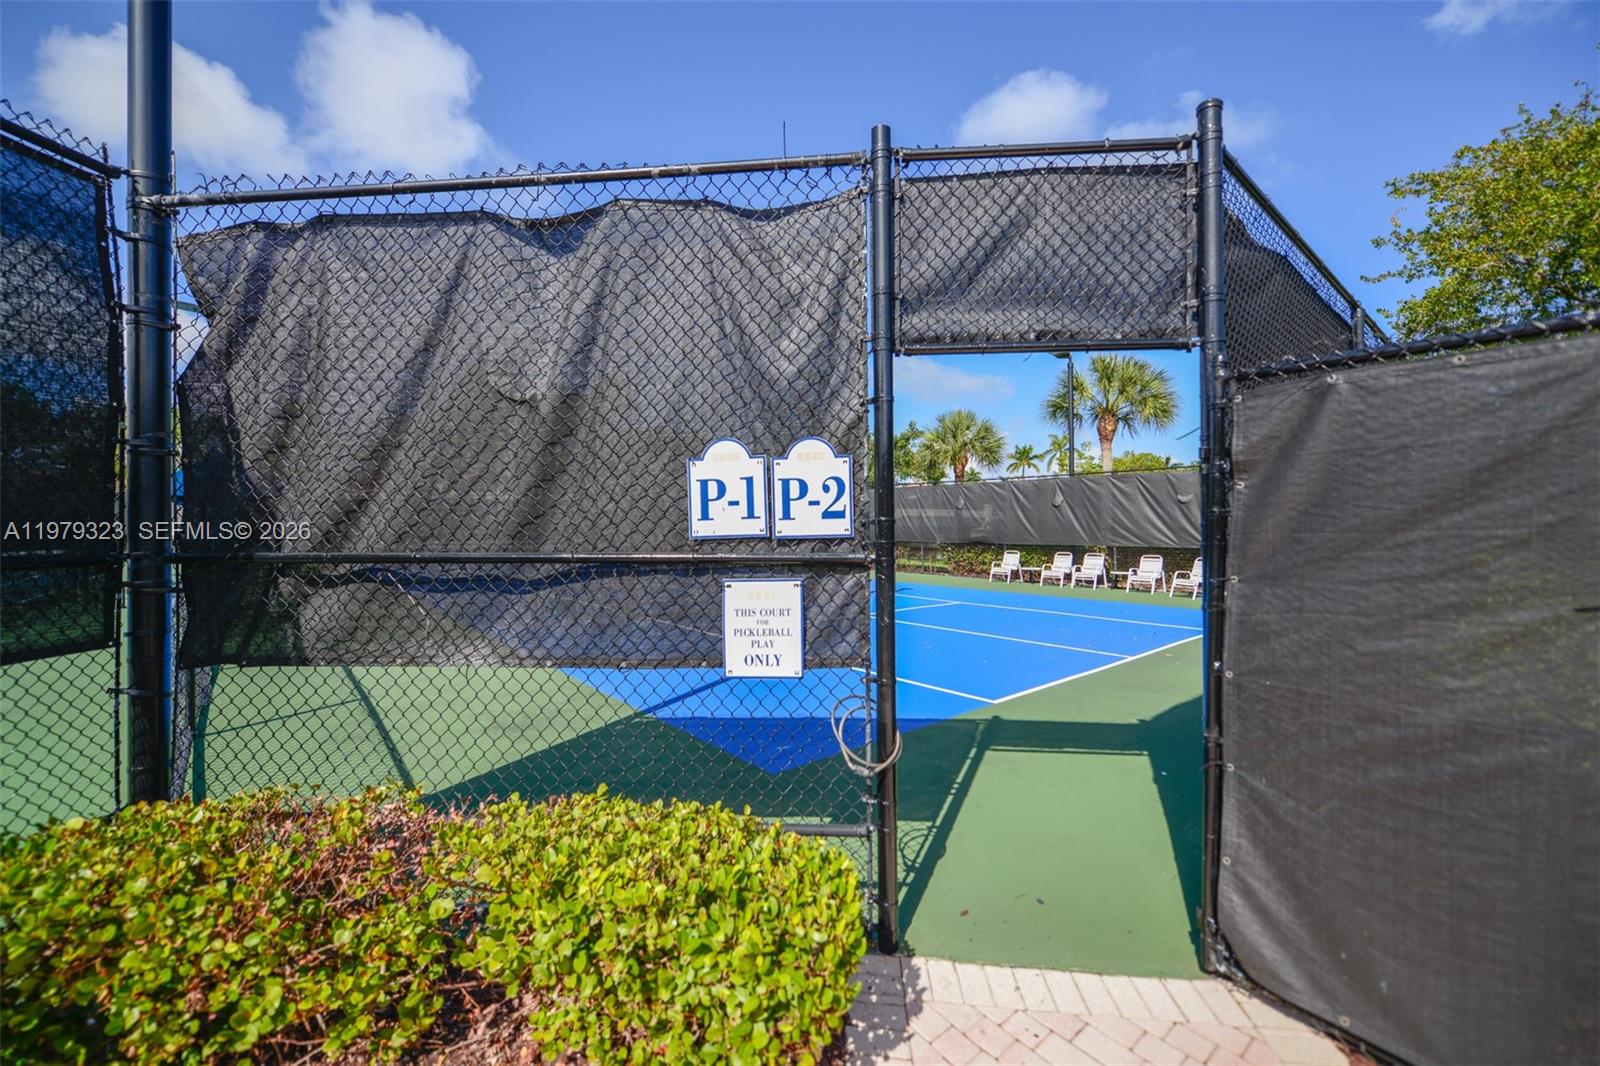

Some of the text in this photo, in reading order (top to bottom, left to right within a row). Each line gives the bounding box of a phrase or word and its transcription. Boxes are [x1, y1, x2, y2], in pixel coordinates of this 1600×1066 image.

[696, 475, 761, 521] P-1
[777, 475, 847, 521] P-2
[733, 608, 792, 617] THIS COURT
[733, 628, 793, 637] PICKLEBALL
[751, 639, 775, 648] PLAY
[744, 654, 782, 667] ONLY
